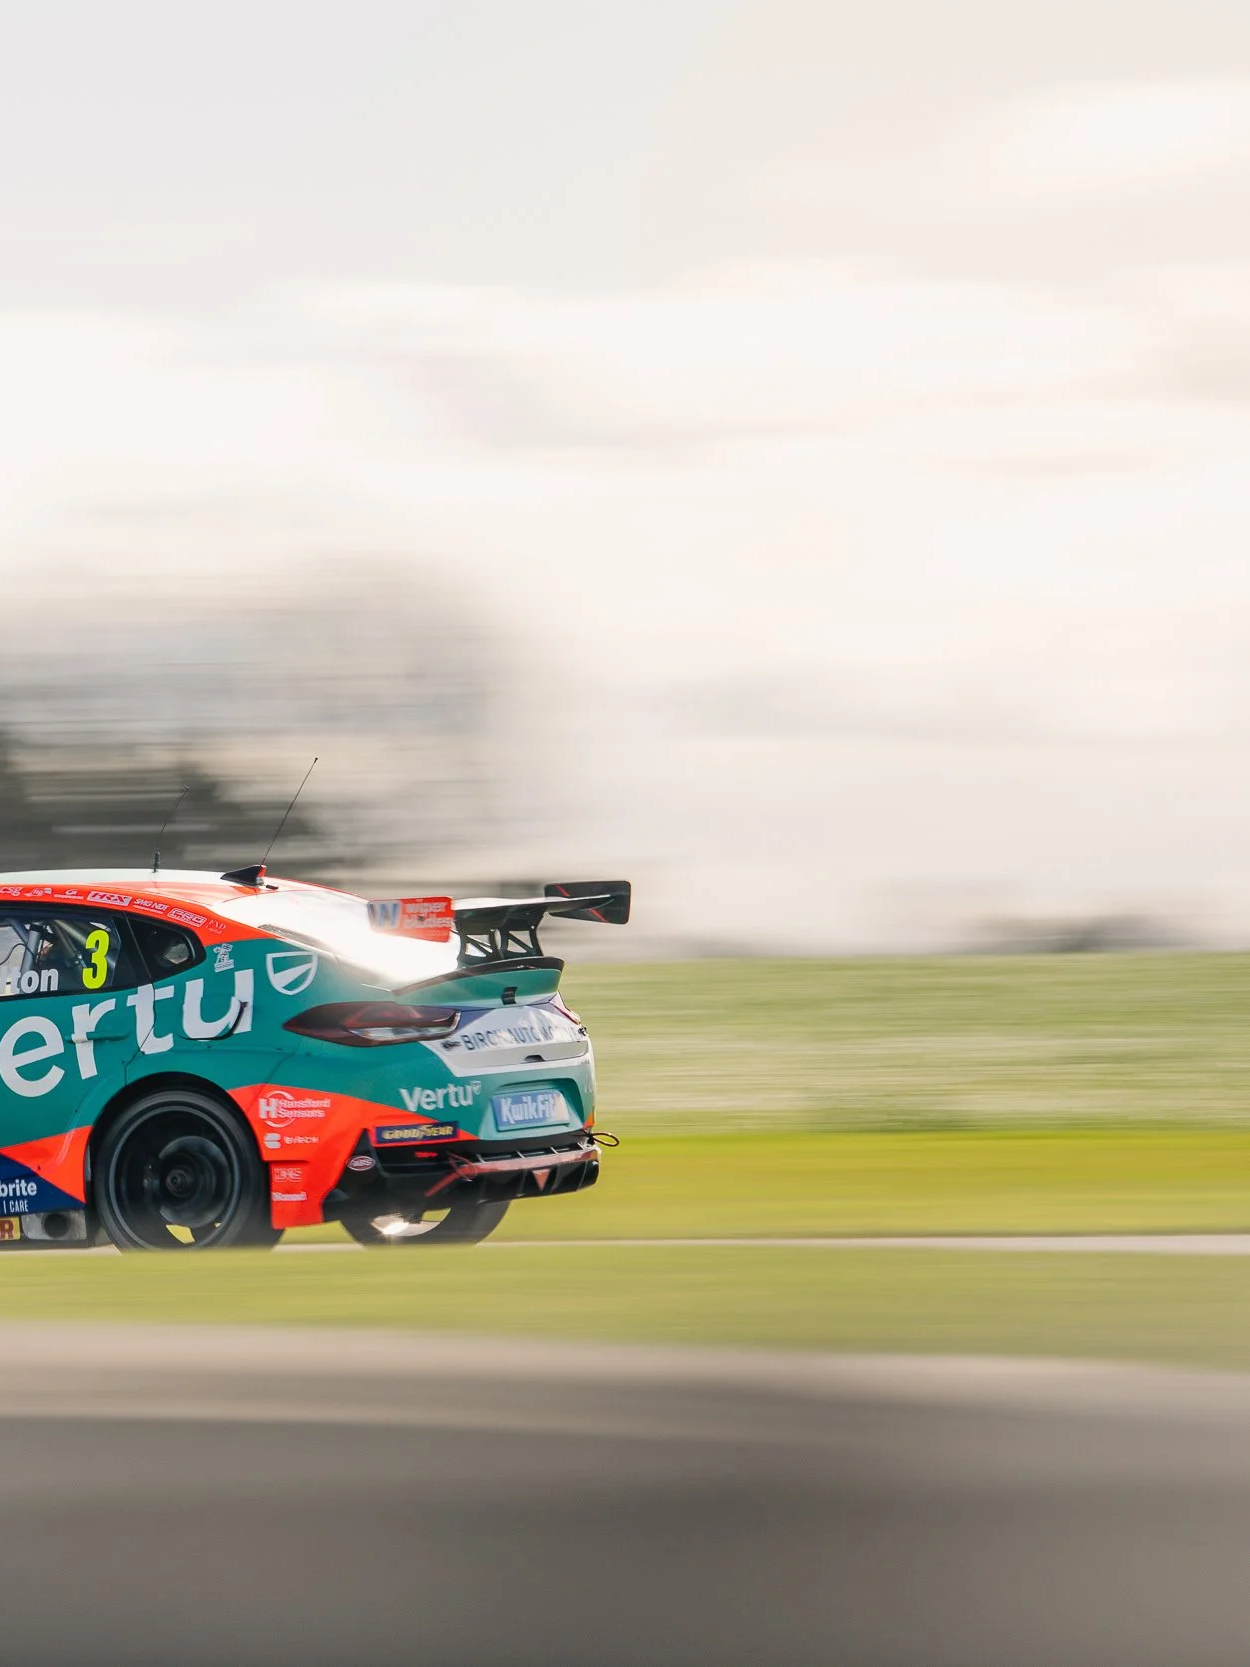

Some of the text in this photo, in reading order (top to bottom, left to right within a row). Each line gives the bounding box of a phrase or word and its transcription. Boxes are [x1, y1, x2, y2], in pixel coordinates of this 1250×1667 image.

[82, 929, 110, 990] 3
[381, 1124, 454, 1141] GOODYEAR
[9, 1200, 29, 1214] CARE
